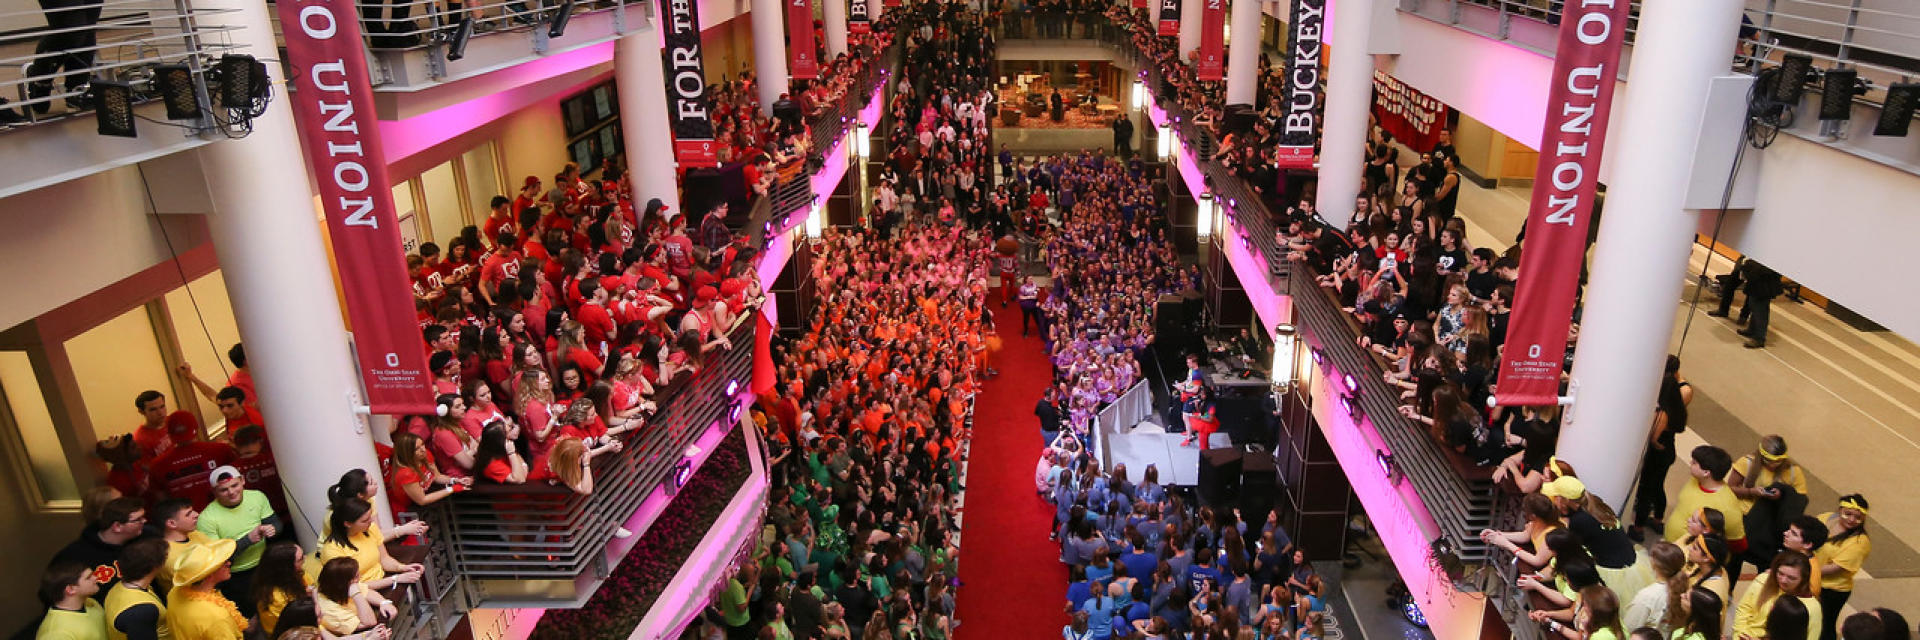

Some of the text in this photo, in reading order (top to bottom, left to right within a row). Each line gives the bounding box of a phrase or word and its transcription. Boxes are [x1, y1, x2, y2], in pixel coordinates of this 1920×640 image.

[672, 44, 708, 121] FOR
[1285, 0, 1324, 135] BUCKEY
[311, 58, 379, 230] UNION
[1545, 63, 1604, 227] UNION
